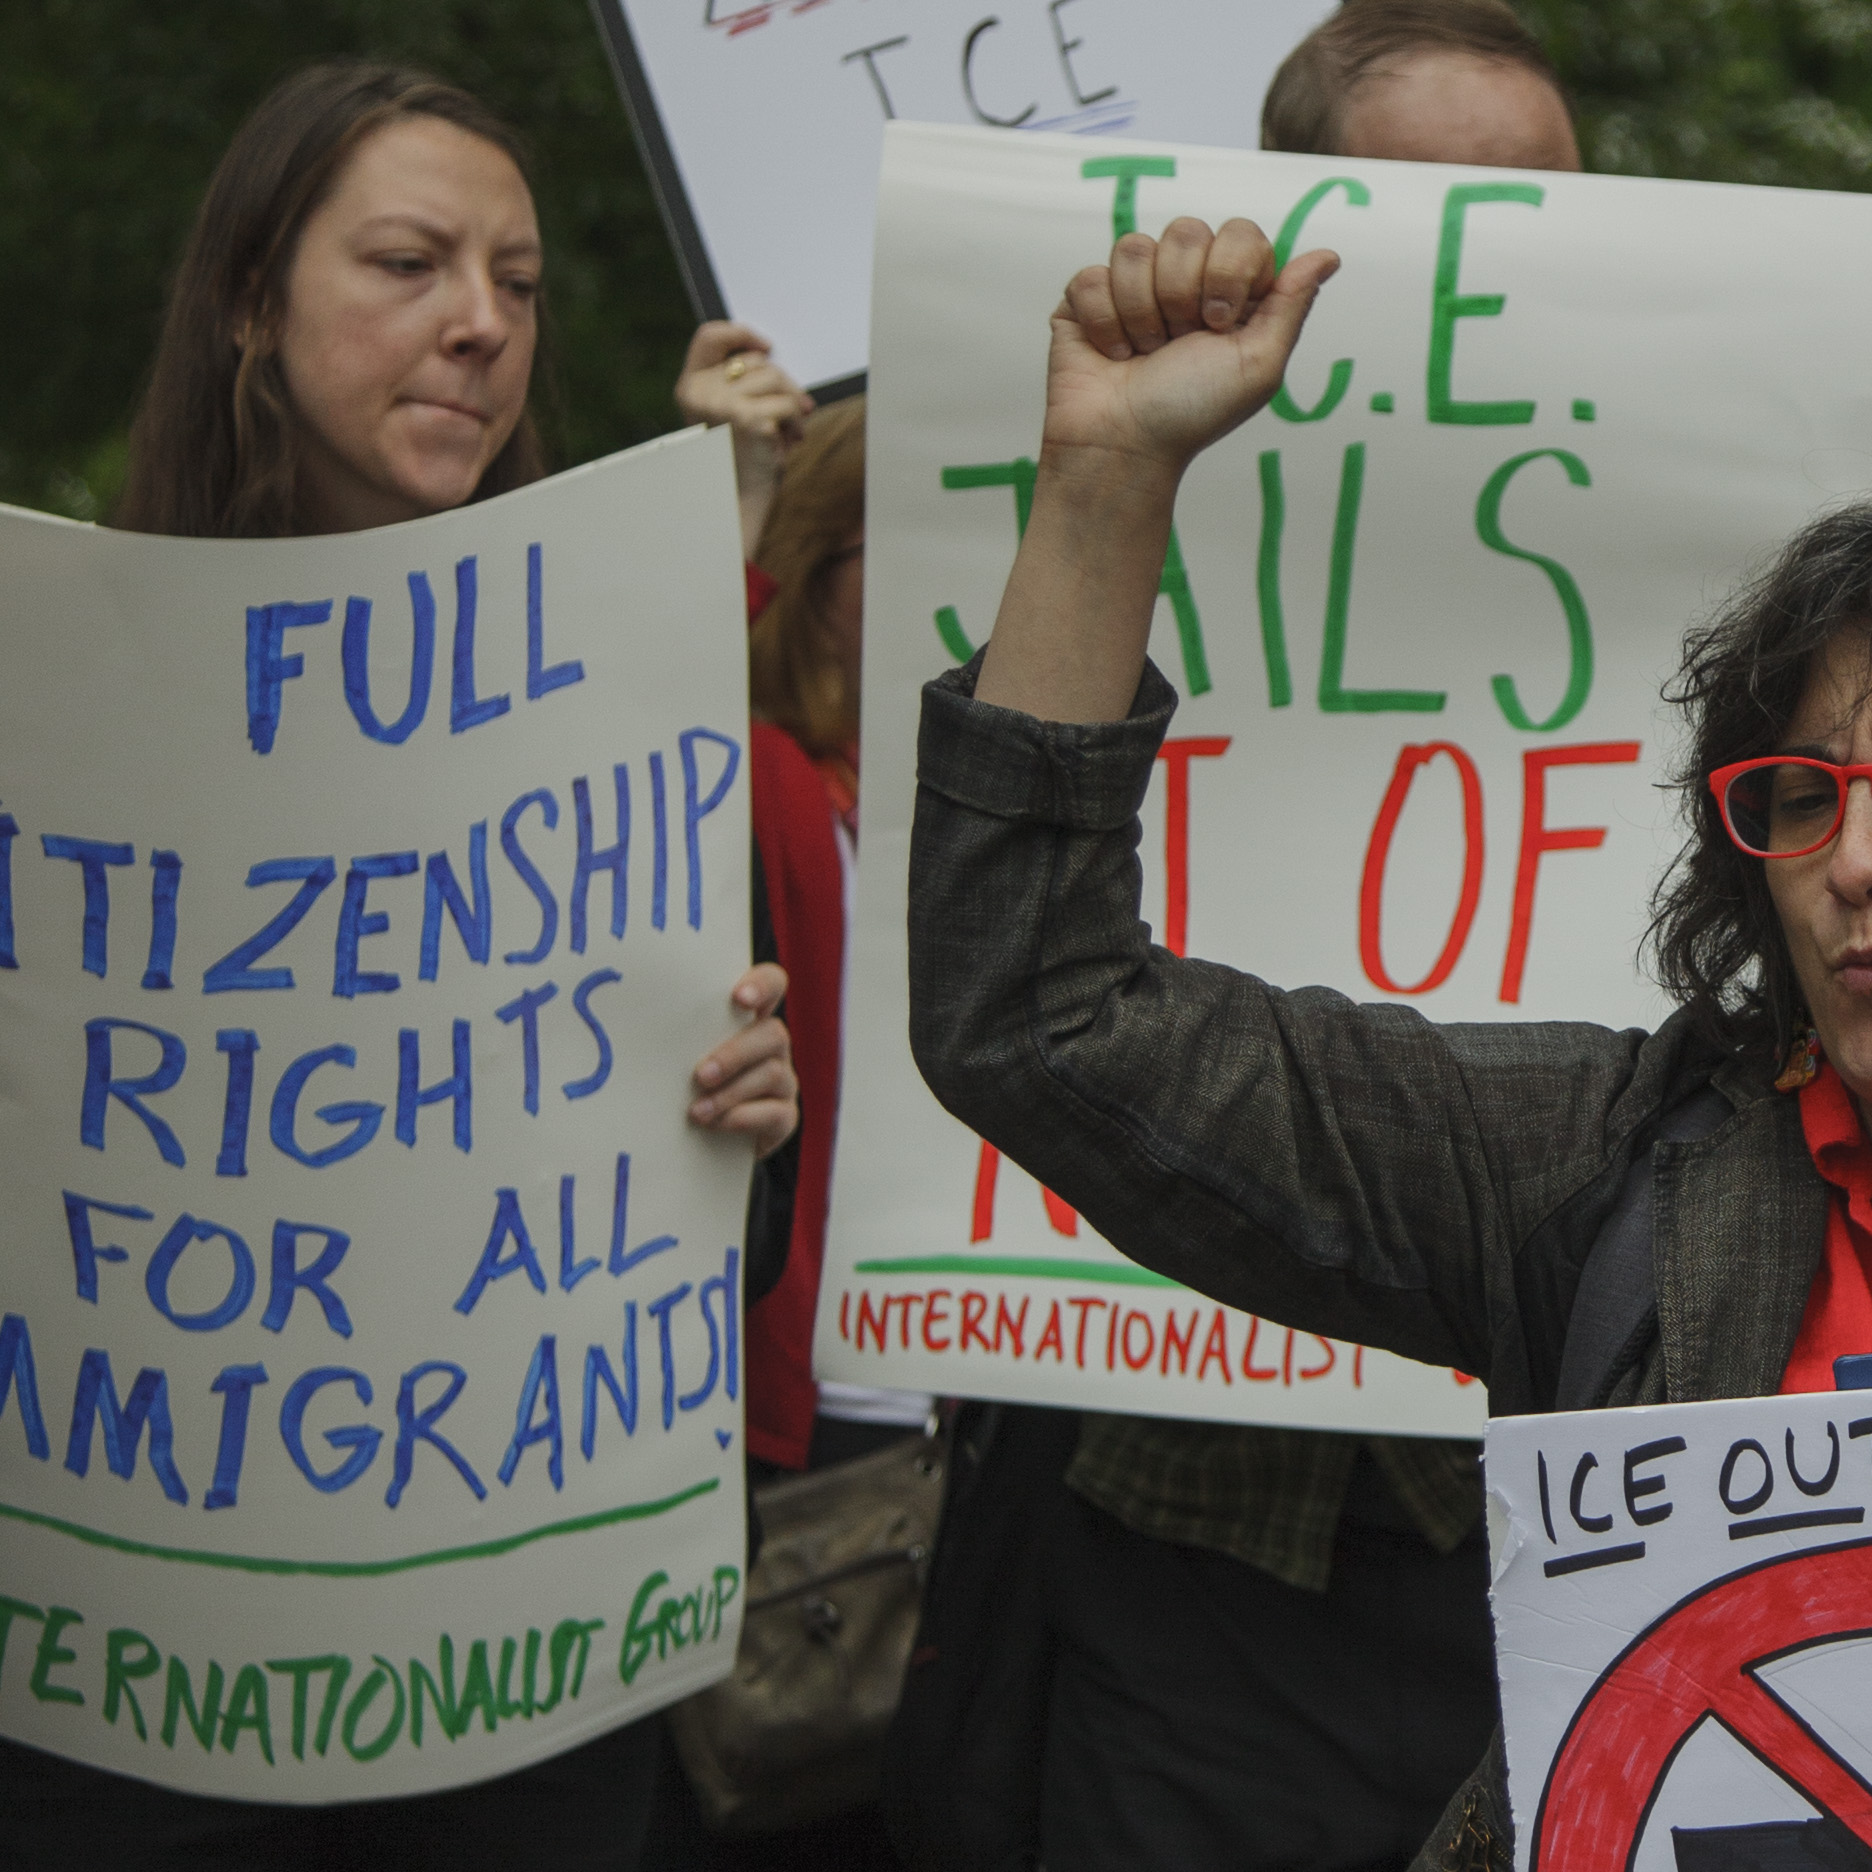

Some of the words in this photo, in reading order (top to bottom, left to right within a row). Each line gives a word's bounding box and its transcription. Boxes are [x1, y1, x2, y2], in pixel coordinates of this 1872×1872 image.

[246, 542, 586, 756] FULL
[0, 725, 742, 1000] ITIZENSHIP
[1357, 740, 1643, 1005] OF
[80, 967, 624, 1178] RIGHTS
[62, 1190, 354, 1340] FOR
[453, 1152, 681, 1316] ALL
[1537, 1436, 1688, 1544] ICE
